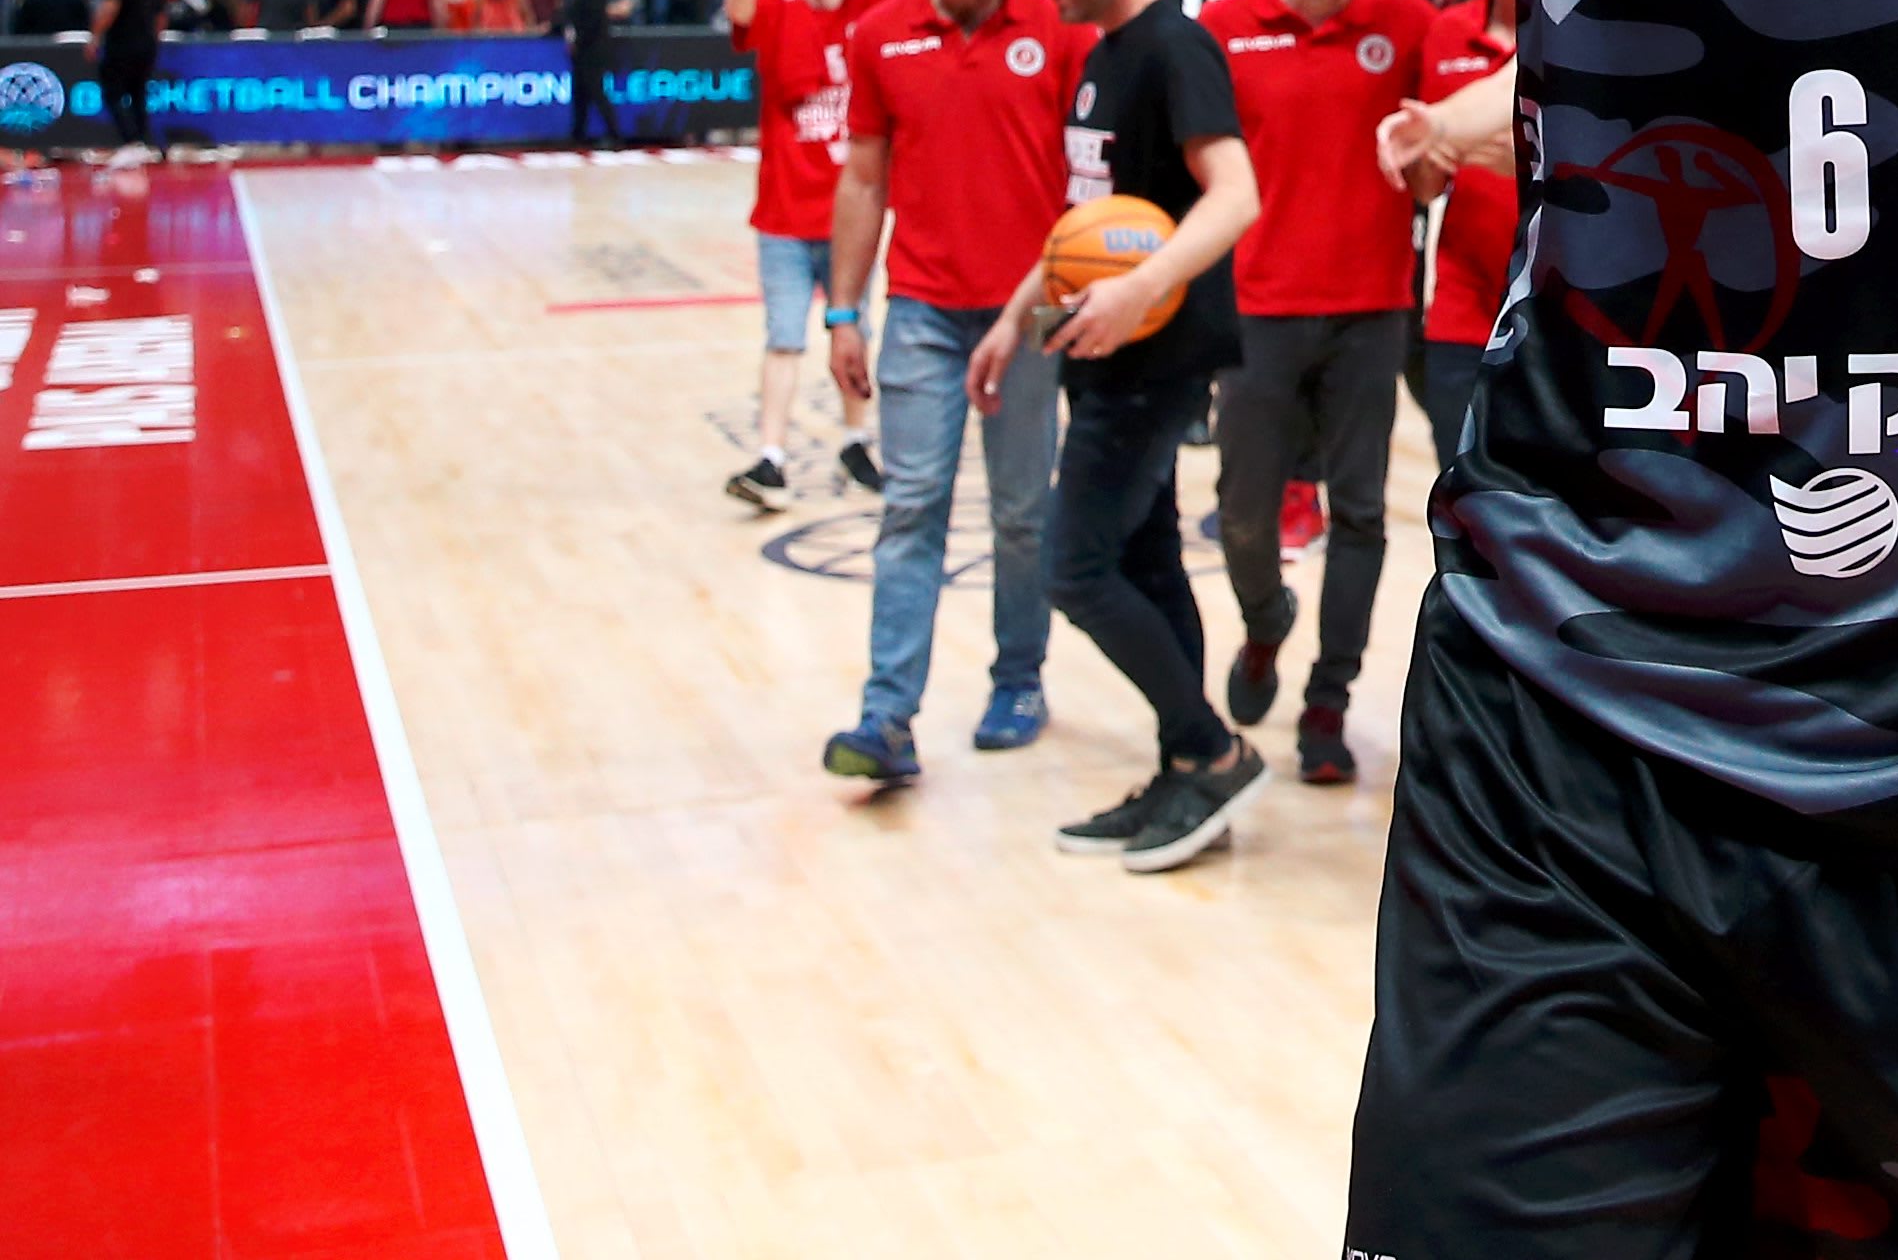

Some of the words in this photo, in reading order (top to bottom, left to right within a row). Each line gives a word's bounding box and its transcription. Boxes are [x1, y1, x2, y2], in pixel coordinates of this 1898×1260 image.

[70, 75, 345, 117] BSKETBALL
[347, 71, 573, 111] CHAMPION
[1788, 69, 1871, 260] 6
[1604, 346, 1819, 435] יהב
